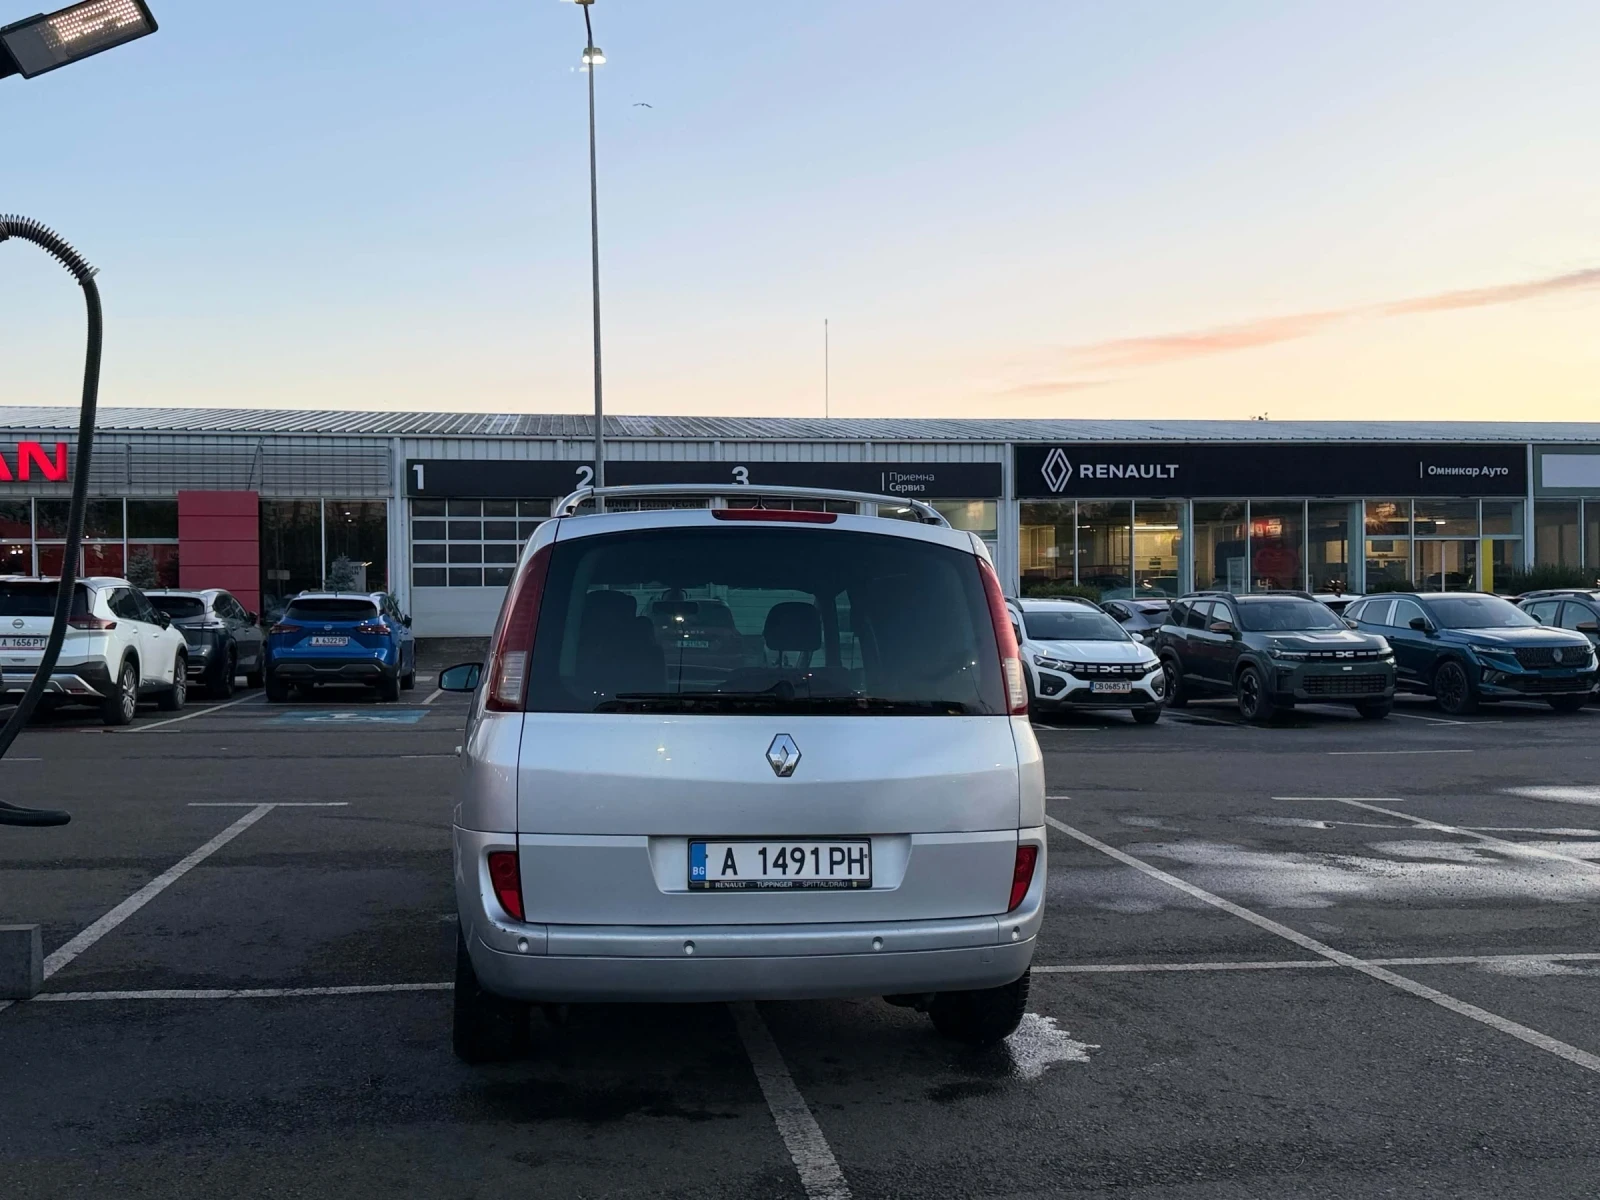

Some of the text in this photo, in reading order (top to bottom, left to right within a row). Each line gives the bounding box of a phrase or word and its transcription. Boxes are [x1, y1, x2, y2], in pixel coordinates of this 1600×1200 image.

[412, 464, 424, 490] 1
[575, 465, 594, 490] 2
[731, 465, 749, 485] 3
[889, 471, 935, 483] Приемна
[1079, 464, 1179, 478] RENAULT
[1427, 465, 1509, 478] Омникар Ауто
[889, 482, 926, 493] Сервиз
[721, 847, 738, 876] A
[692, 866, 705, 875] BG
[715, 881, 747, 889] RENAULT
